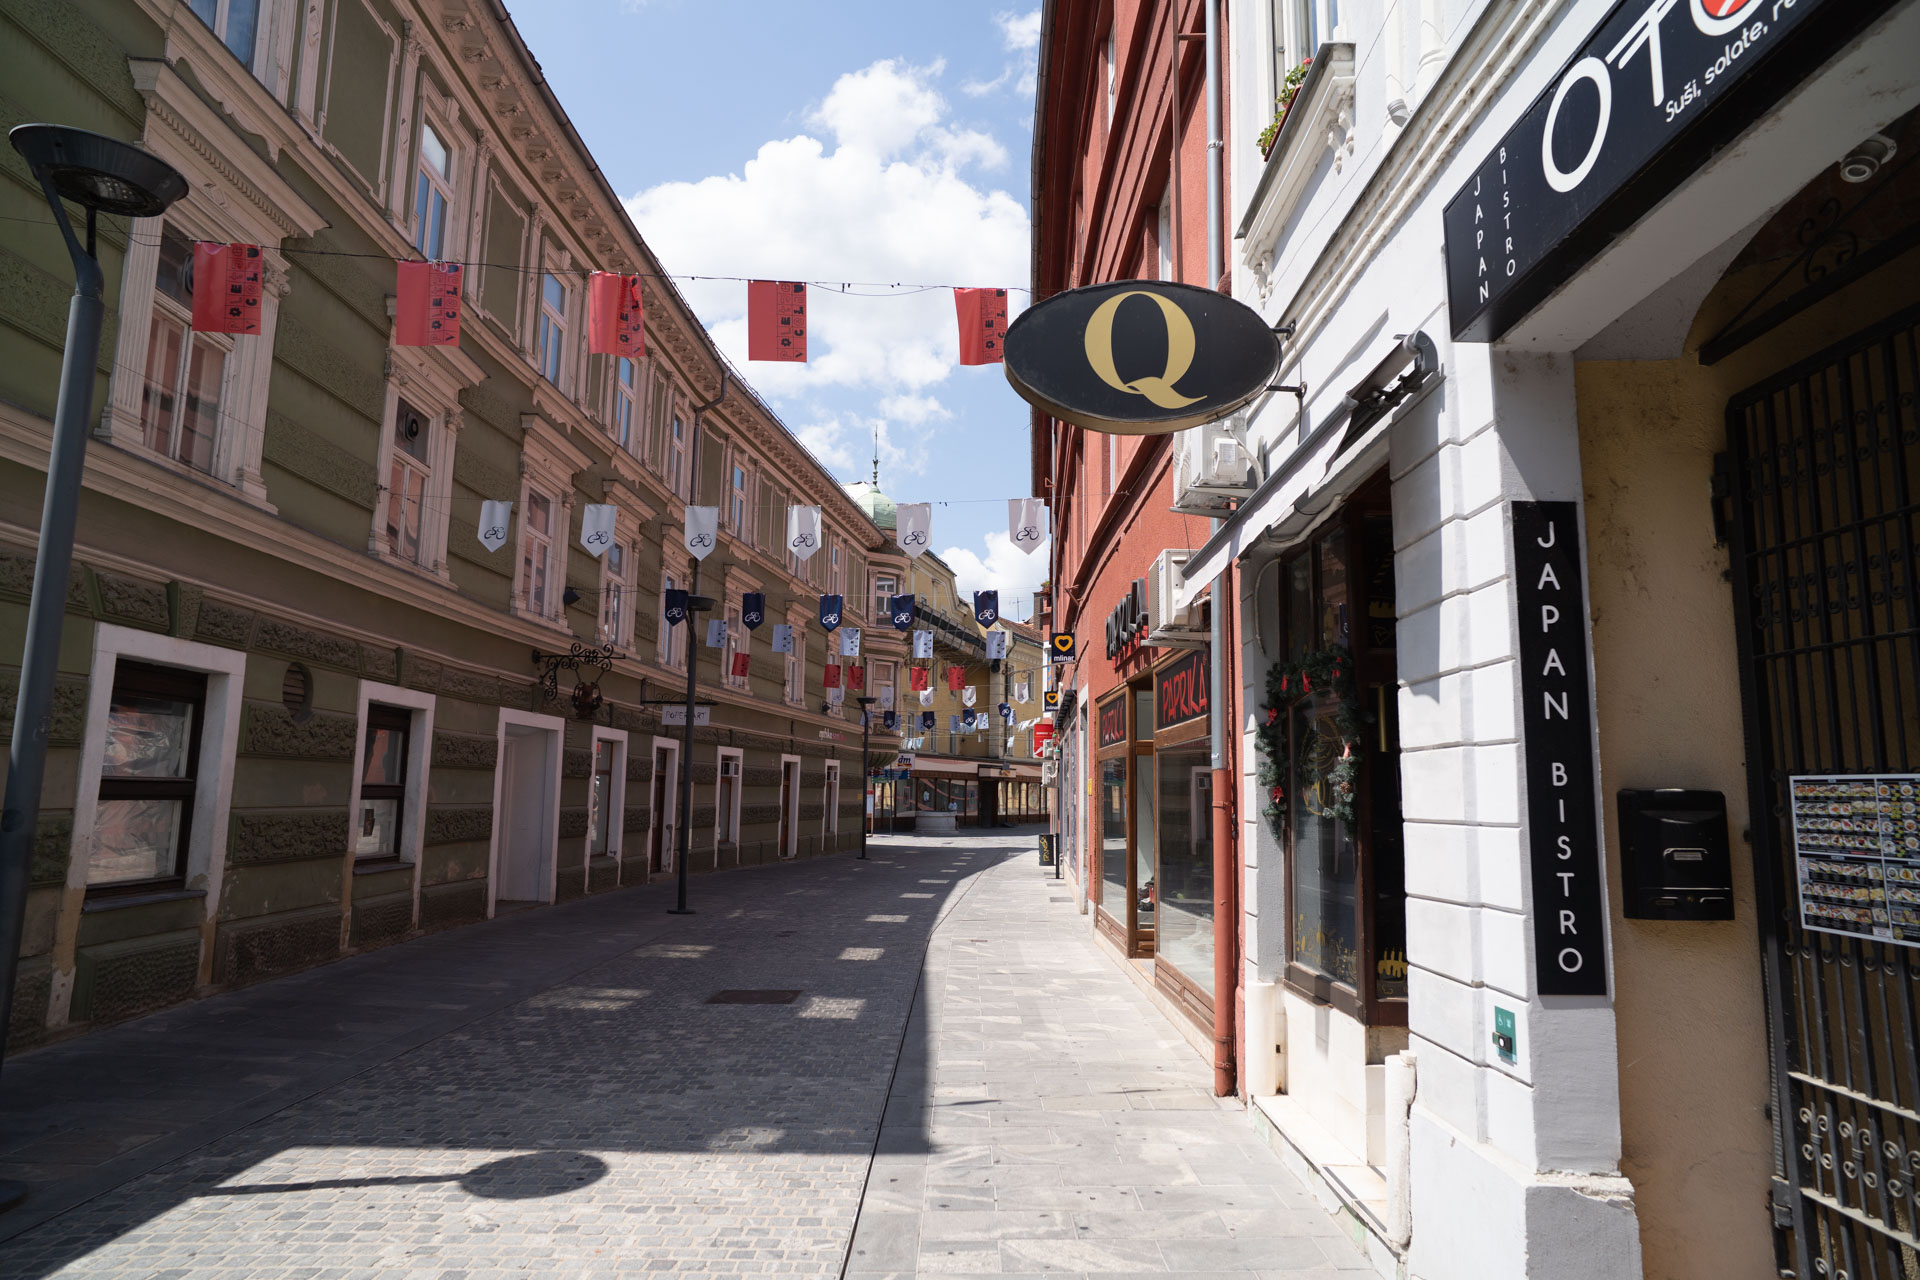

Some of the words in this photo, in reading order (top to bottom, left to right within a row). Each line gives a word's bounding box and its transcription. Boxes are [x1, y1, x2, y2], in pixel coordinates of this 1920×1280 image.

[1542, 0, 1764, 193] OT
[1666, 79, 1702, 122] Suši,
[1704, 21, 1769, 85] solate,
[1474, 176, 1490, 303] JAPAN
[1500, 147, 1516, 276] BISTRO
[1084, 291, 1208, 409] Q
[1053, 654, 1075, 662] mlinar
[1537, 521, 1568, 720] JAPAN
[1162, 656, 1208, 725] PAPRIKA
[1551, 762, 1583, 973] BISTRO
